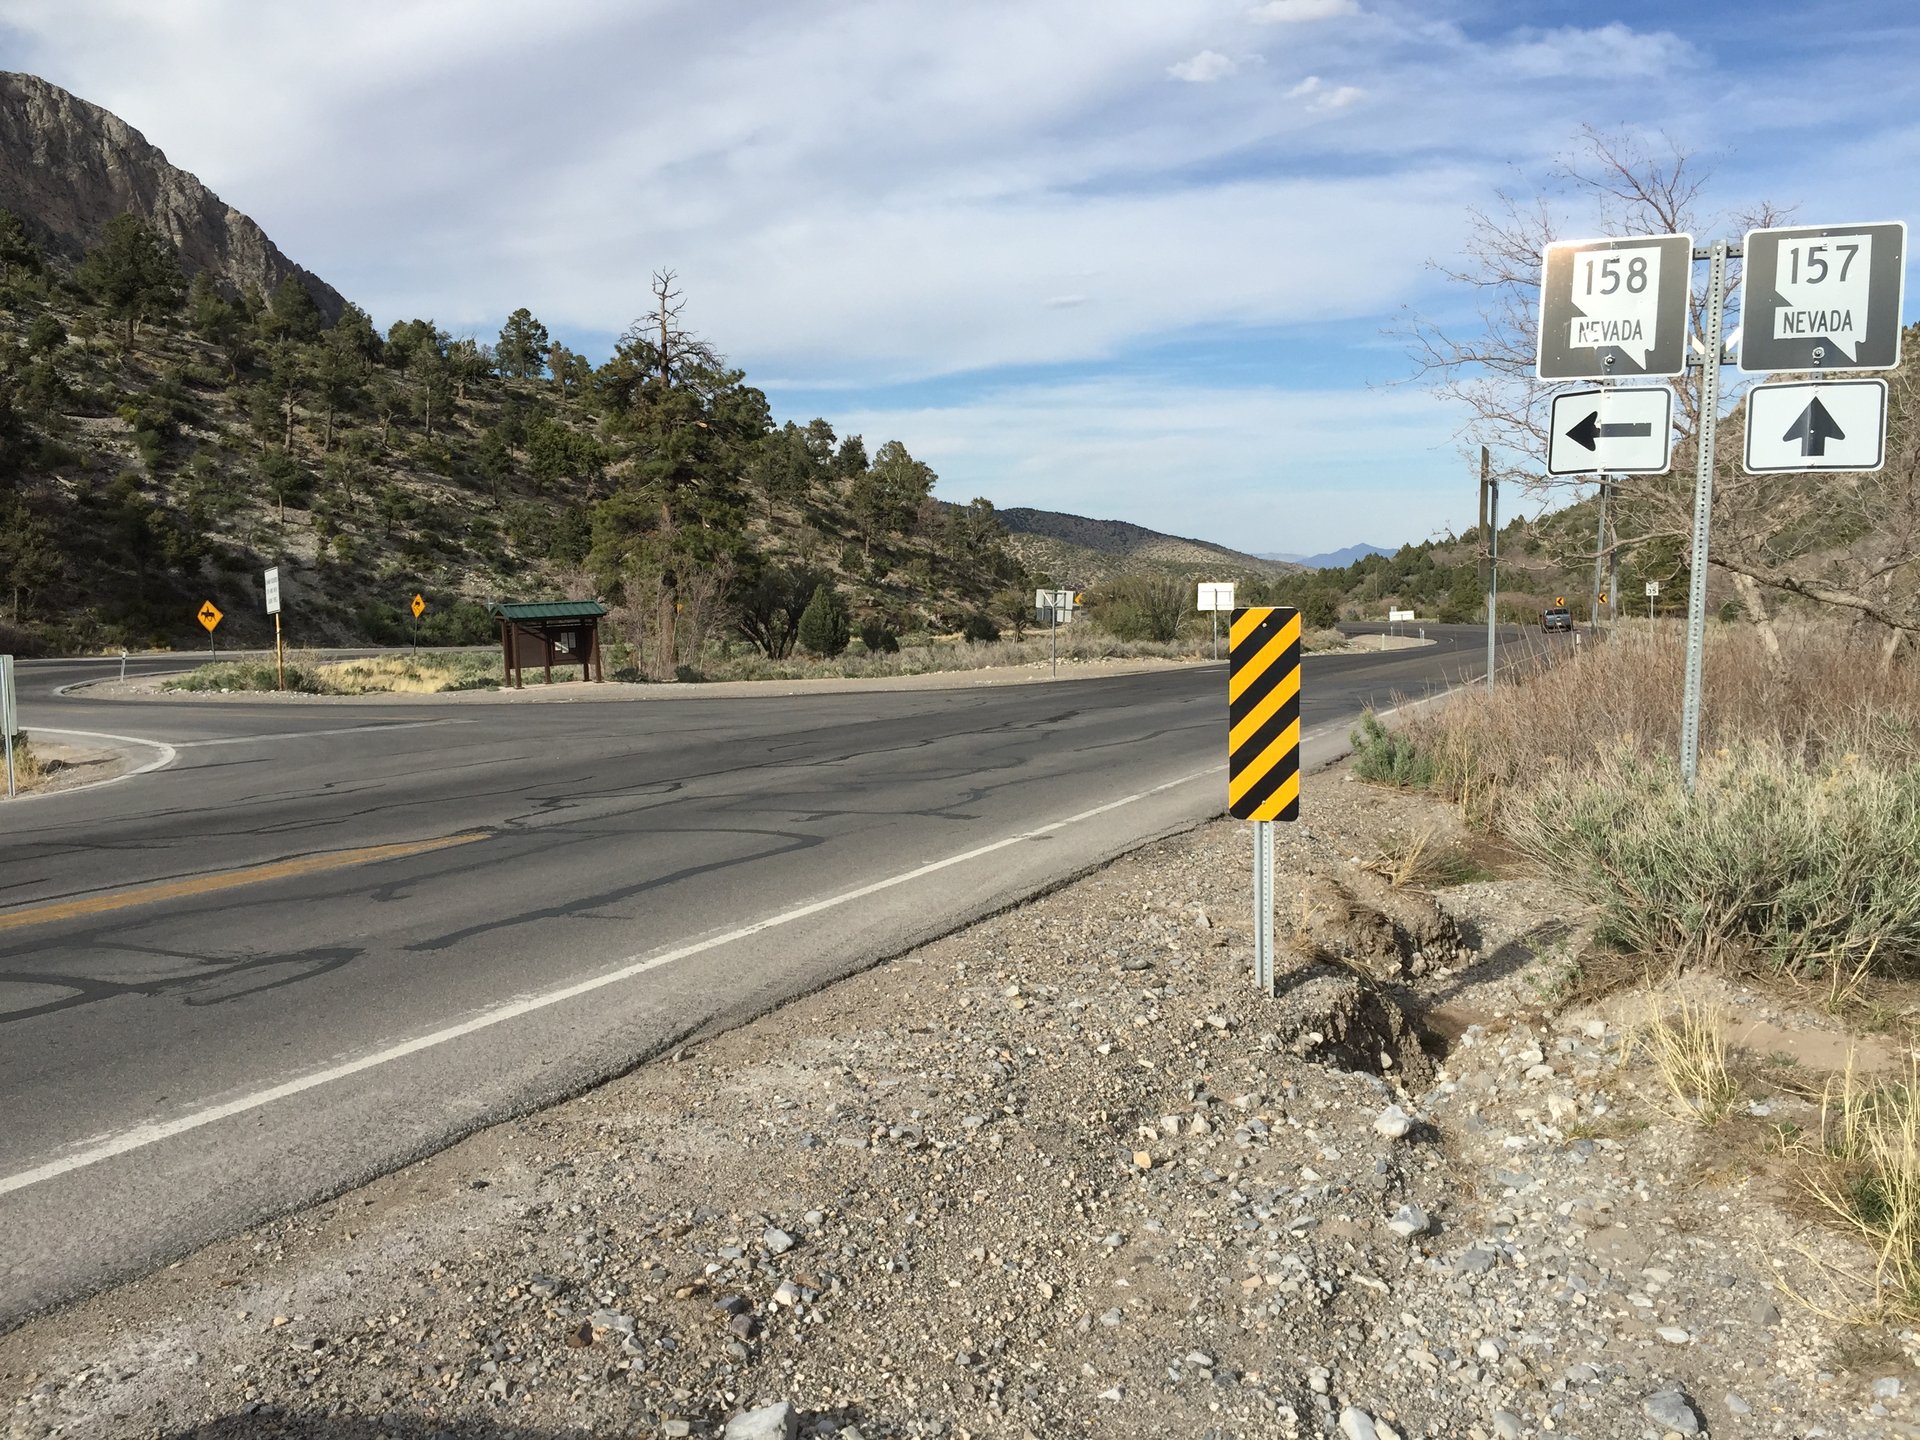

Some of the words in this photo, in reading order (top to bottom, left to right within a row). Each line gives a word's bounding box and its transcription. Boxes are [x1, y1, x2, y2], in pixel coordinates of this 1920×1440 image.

[1586, 256, 1648, 295] 158
[1791, 244, 1859, 285] 157
[1578, 319, 1643, 343] NEVADA
[1783, 309, 1853, 334] NEVADA
